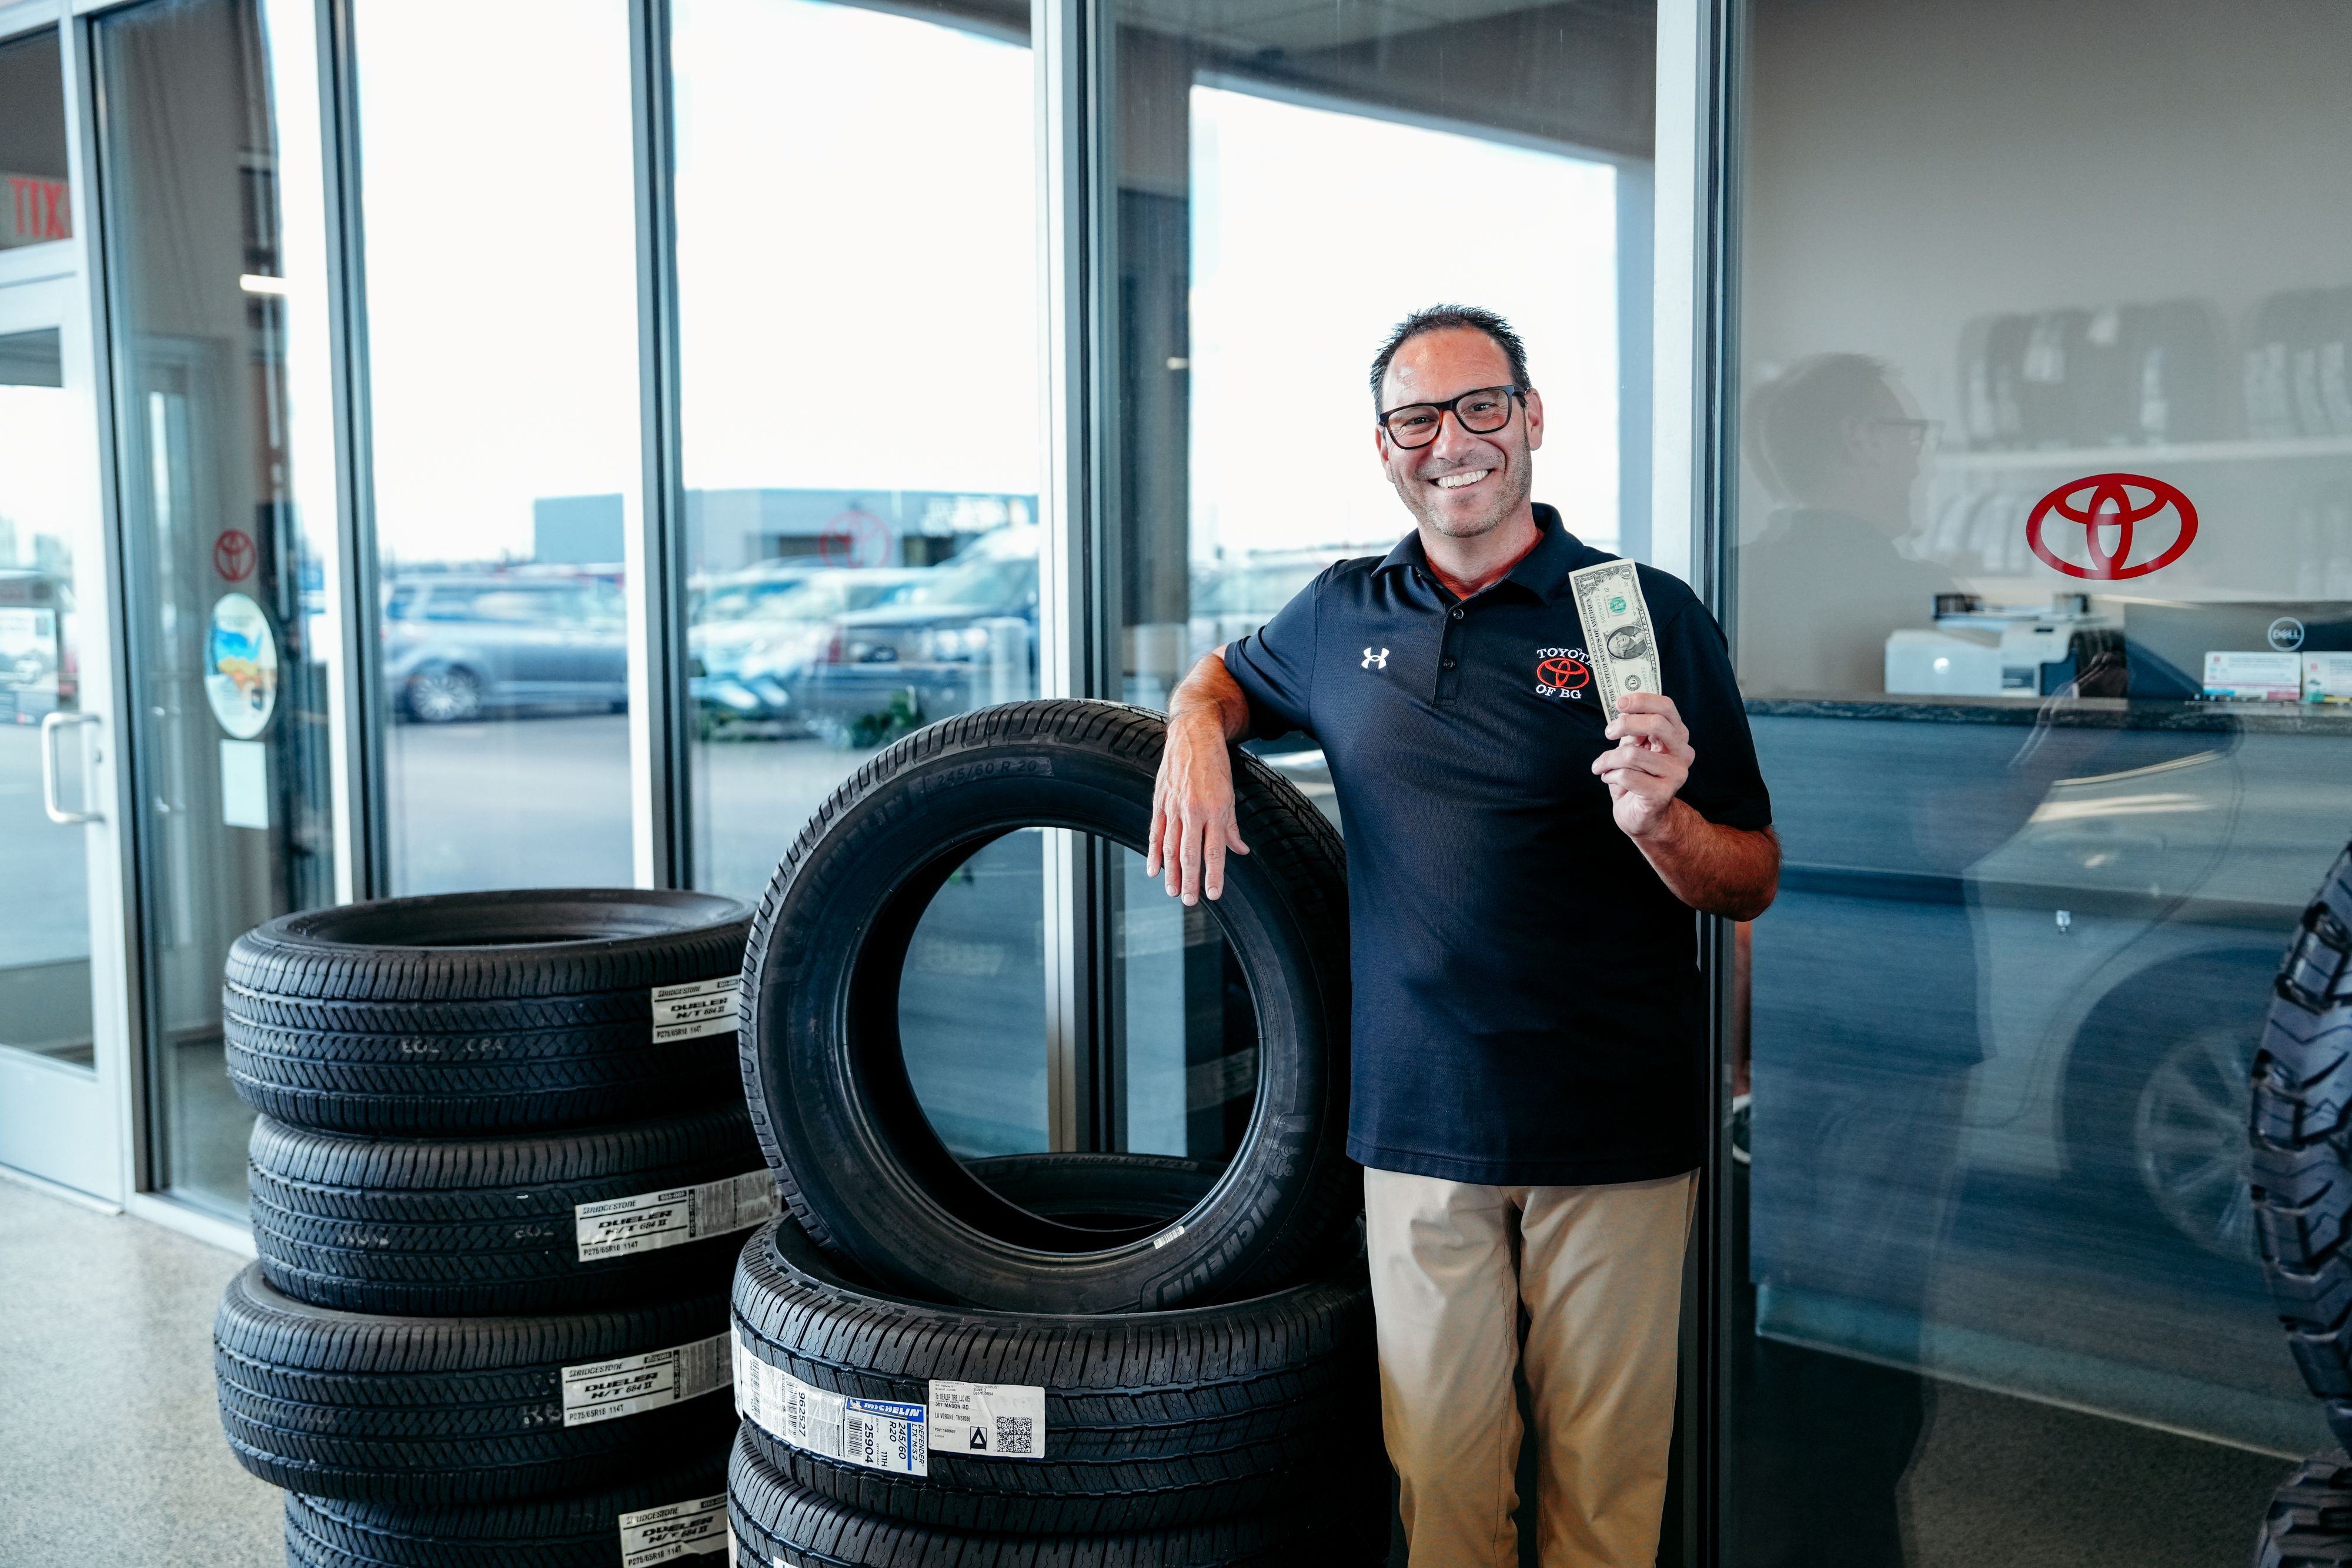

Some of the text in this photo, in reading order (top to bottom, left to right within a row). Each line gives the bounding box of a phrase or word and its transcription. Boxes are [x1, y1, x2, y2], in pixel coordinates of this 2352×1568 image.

[1586, 599, 1597, 628] AMERICA
[1593, 629, 1599, 637] OF
[2272, 629, 2300, 640] DELL
[1596, 638, 1606, 662] STATES
[1602, 663, 1612, 687] UNITED
[1536, 684, 1582, 699] OF BG
[937, 760, 1037, 786] 245/60 R 20
[658, 985, 701, 997] BRIDGESTONE
[671, 998, 727, 1011] DUELER
[582, 1200, 637, 1215] BRIDGESTONE
[599, 1209, 673, 1229] DUELER
[605, 1223, 637, 1236] H/T
[639, 1221, 656, 1230] 684
[583, 1244, 621, 1256] P275/65R18
[1162, 1179, 1282, 1308] MICHELIN
[569, 1362, 624, 1378] BRIDGESTONE
[584, 1372, 659, 1392] DUELER
[591, 1388, 622, 1399] H/T
[626, 1385, 643, 1393] 684
[569, 1407, 606, 1420] P275/65R18
[609, 1404, 624, 1414] 114T
[864, 1402, 921, 1417] MICHELIN
[864, 1423, 874, 1463] 25904
[898, 1422, 907, 1460] 245/60
[626, 1507, 679, 1524] BRIDGESTONE
[642, 1516, 714, 1537] DUELER
[681, 1529, 697, 1538] 684
[627, 1544, 682, 1566] P275/65R18 114T
